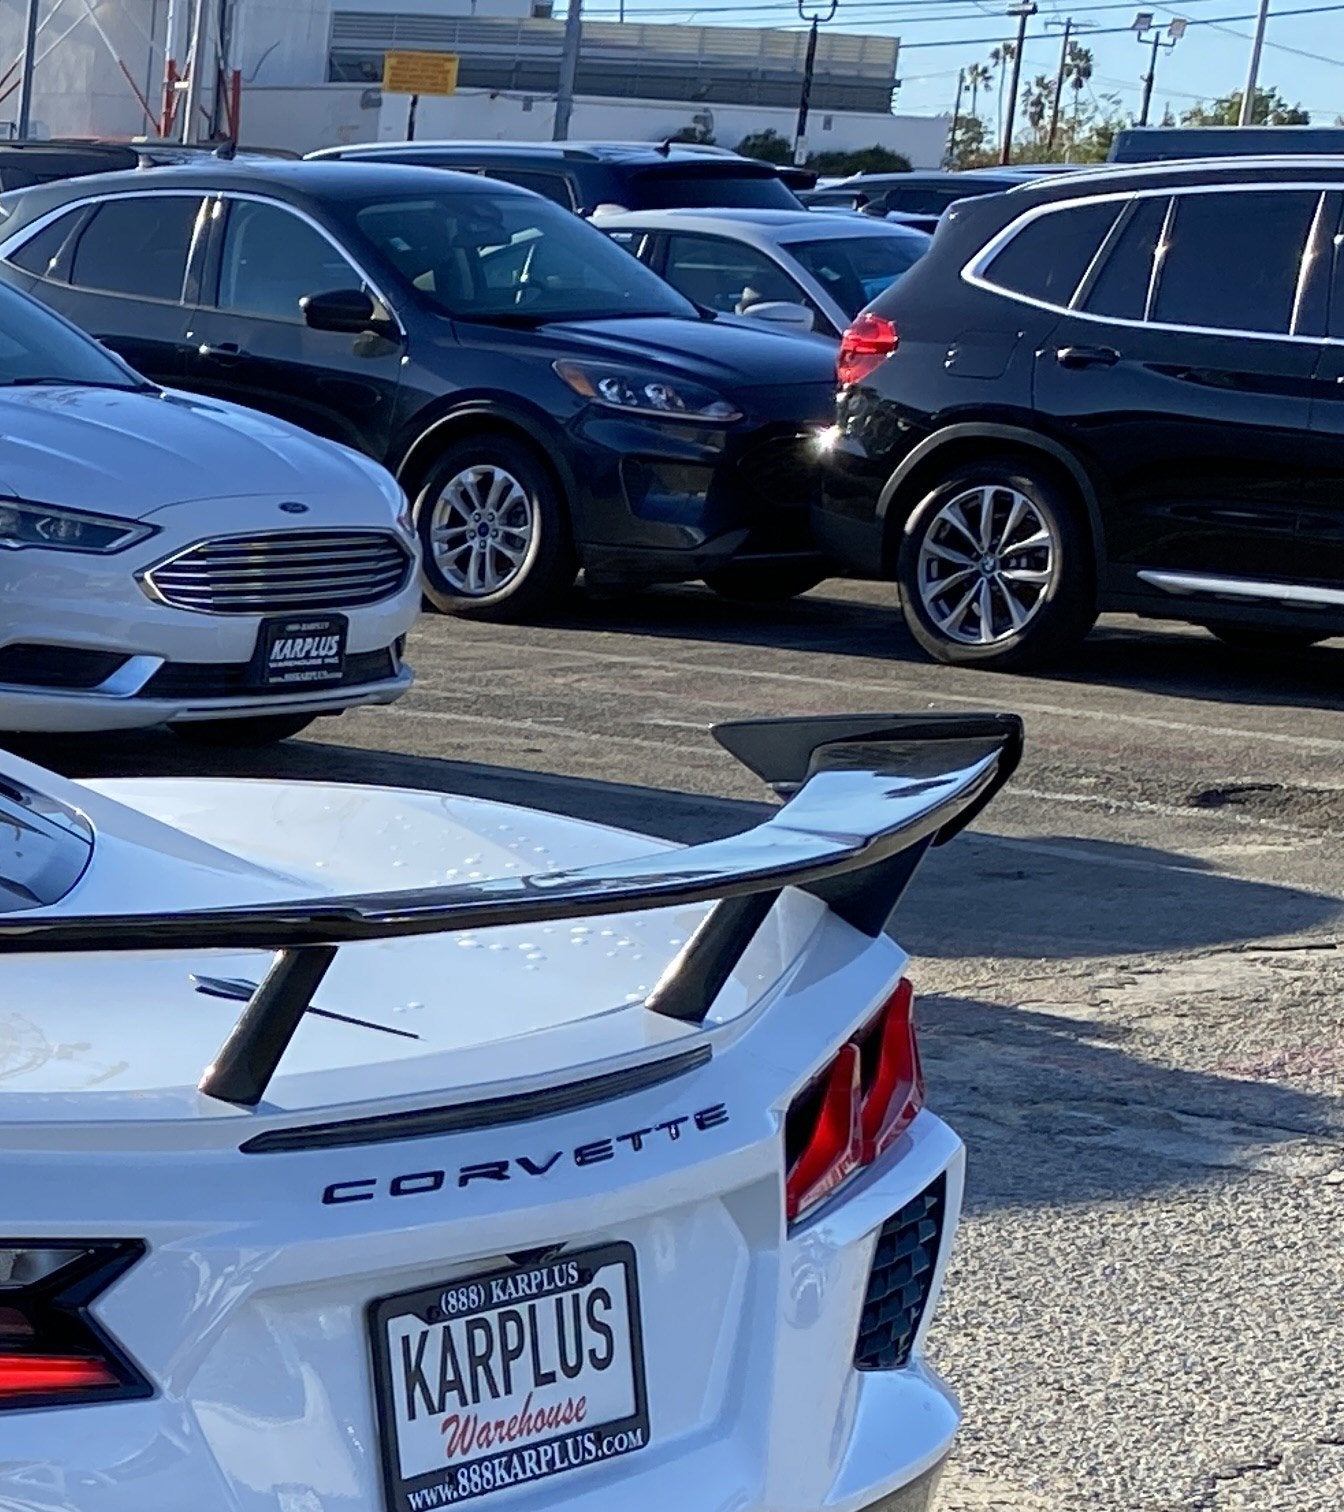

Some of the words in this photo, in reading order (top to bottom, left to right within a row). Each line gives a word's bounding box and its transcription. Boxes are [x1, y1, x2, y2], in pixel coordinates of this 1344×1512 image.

[270, 635, 340, 660] KARPLUS
[322, 1102, 730, 1205] CORVETTE
[440, 1285, 485, 1315] (888)
[491, 1261, 579, 1303] KARPLUS
[401, 1287, 614, 1421] KARPLUS
[440, 1391, 587, 1459] Warehouse
